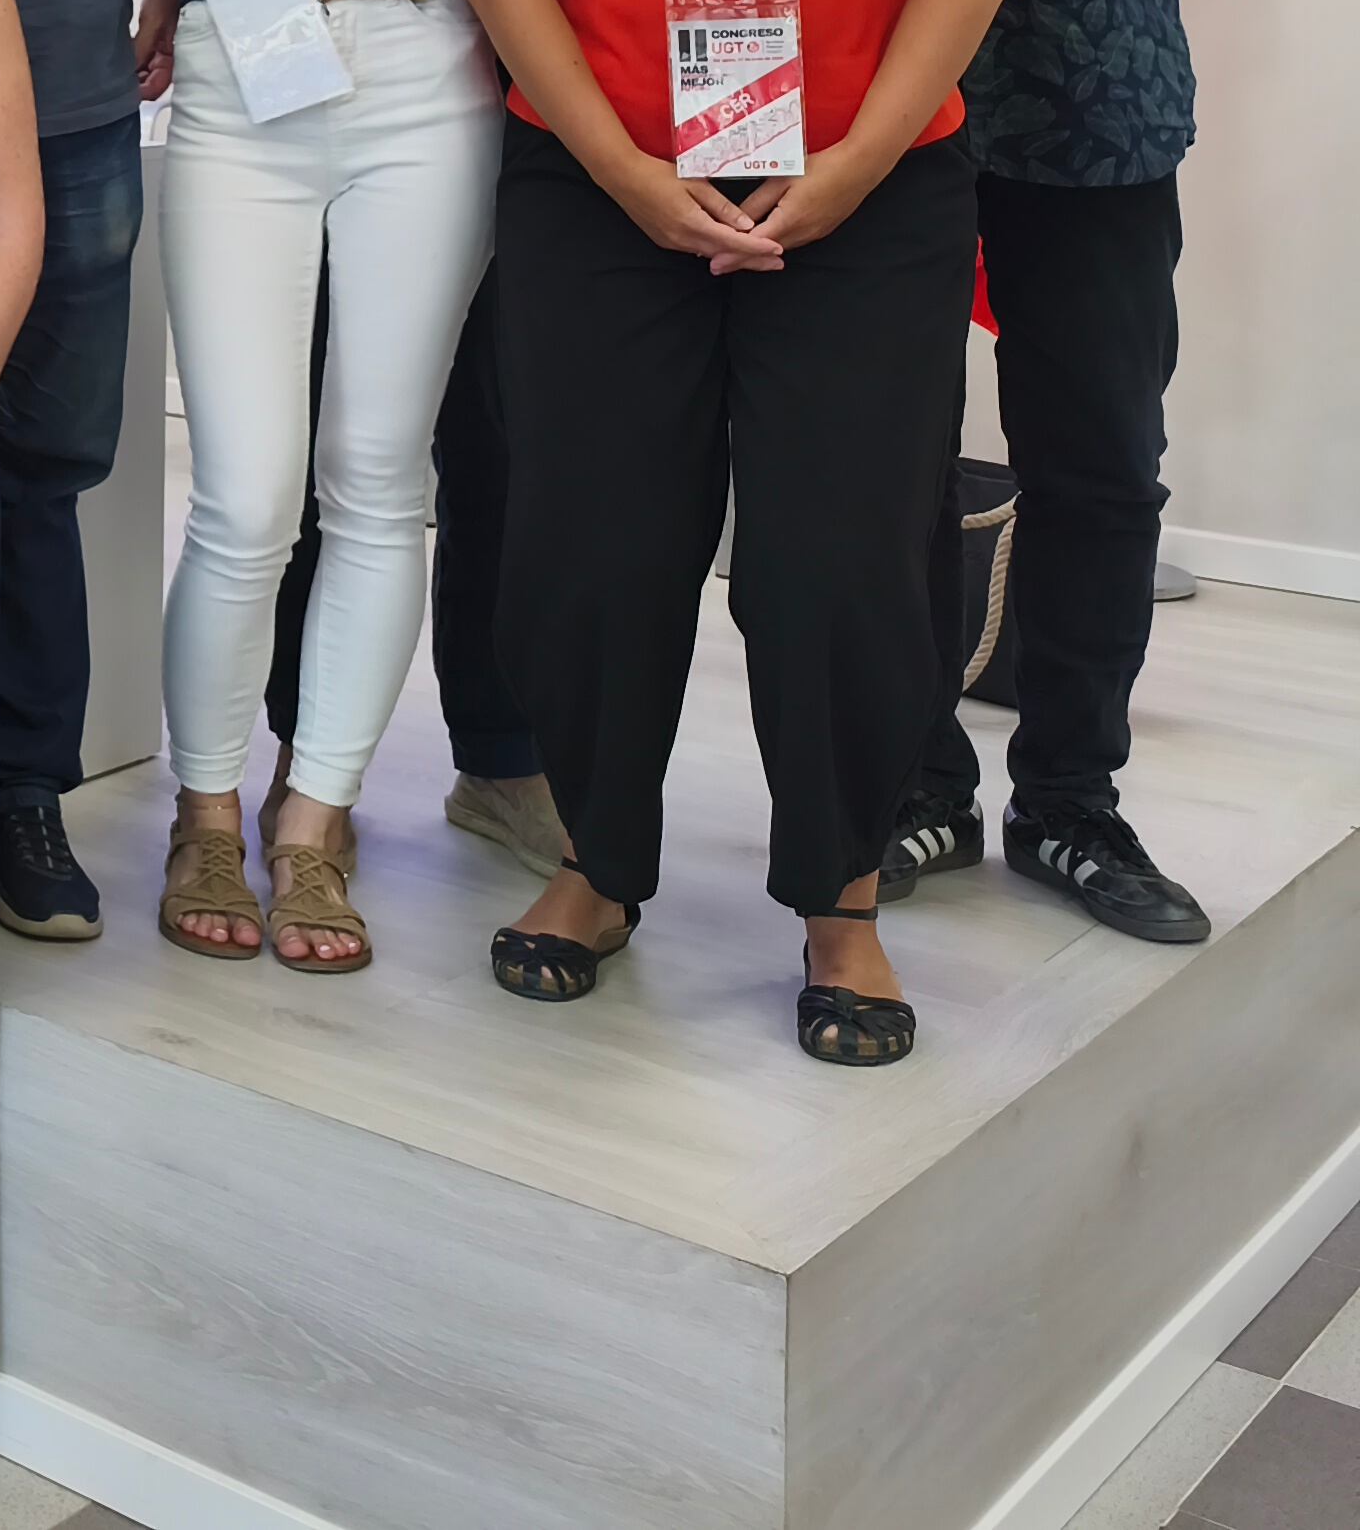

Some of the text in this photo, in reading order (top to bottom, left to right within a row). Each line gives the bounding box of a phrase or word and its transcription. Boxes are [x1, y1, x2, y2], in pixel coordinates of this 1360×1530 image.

[711, 28, 784, 39] CONGRESO
[712, 41, 744, 55] UGT
[680, 63, 709, 75] MÁS
[720, 92, 755, 119] CER
[744, 160, 768, 170] UGT
